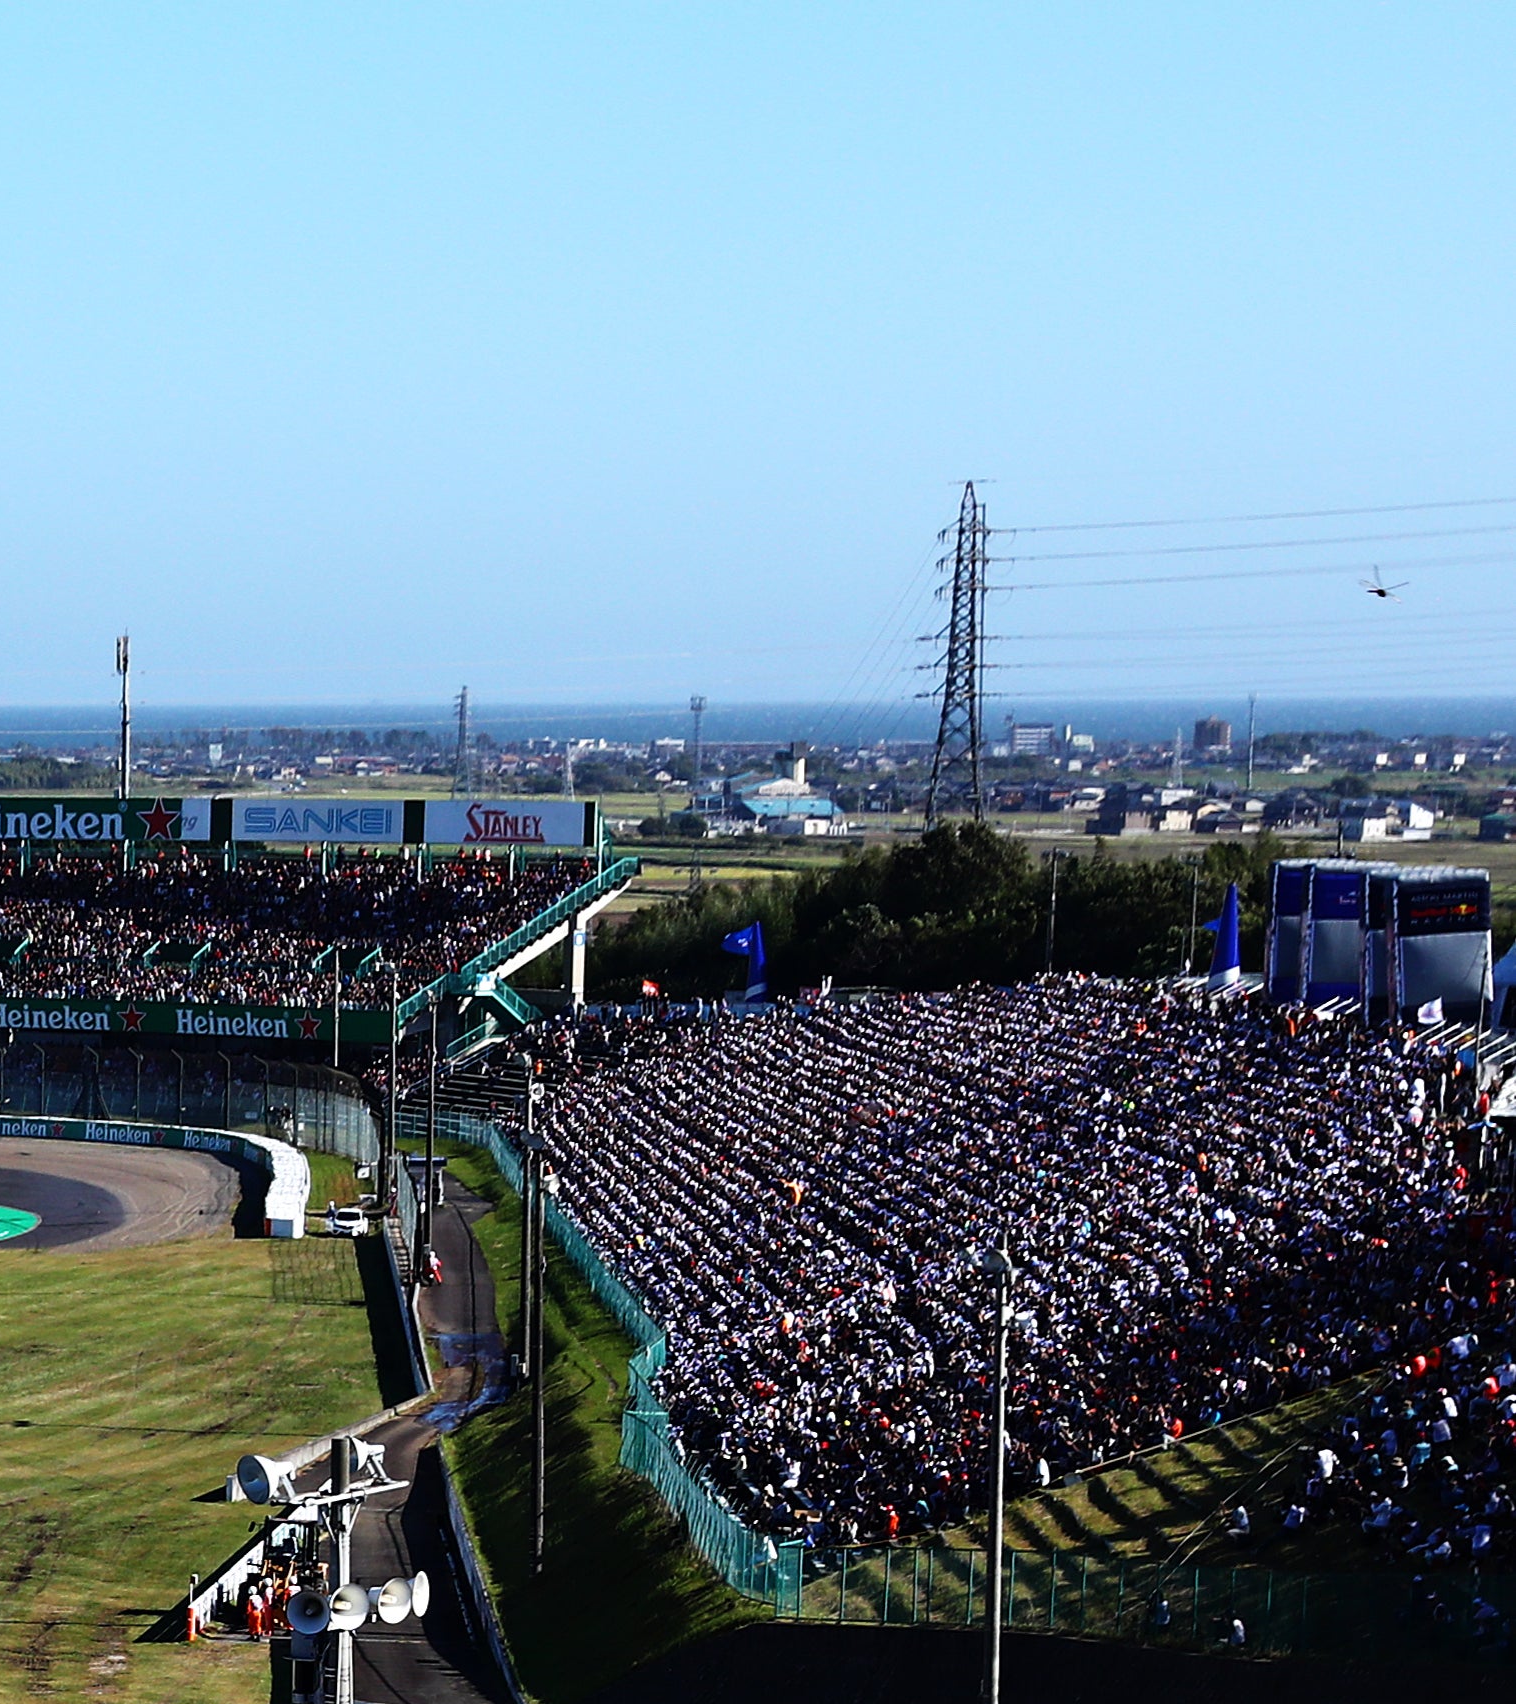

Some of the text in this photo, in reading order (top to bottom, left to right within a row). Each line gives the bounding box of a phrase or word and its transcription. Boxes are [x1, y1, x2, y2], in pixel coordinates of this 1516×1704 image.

[245, 807, 393, 834] SANKEI
[465, 804, 545, 842] STANLEY
[176, 1009, 289, 1039] Heineken
[85, 1122, 151, 1145] Heineken
